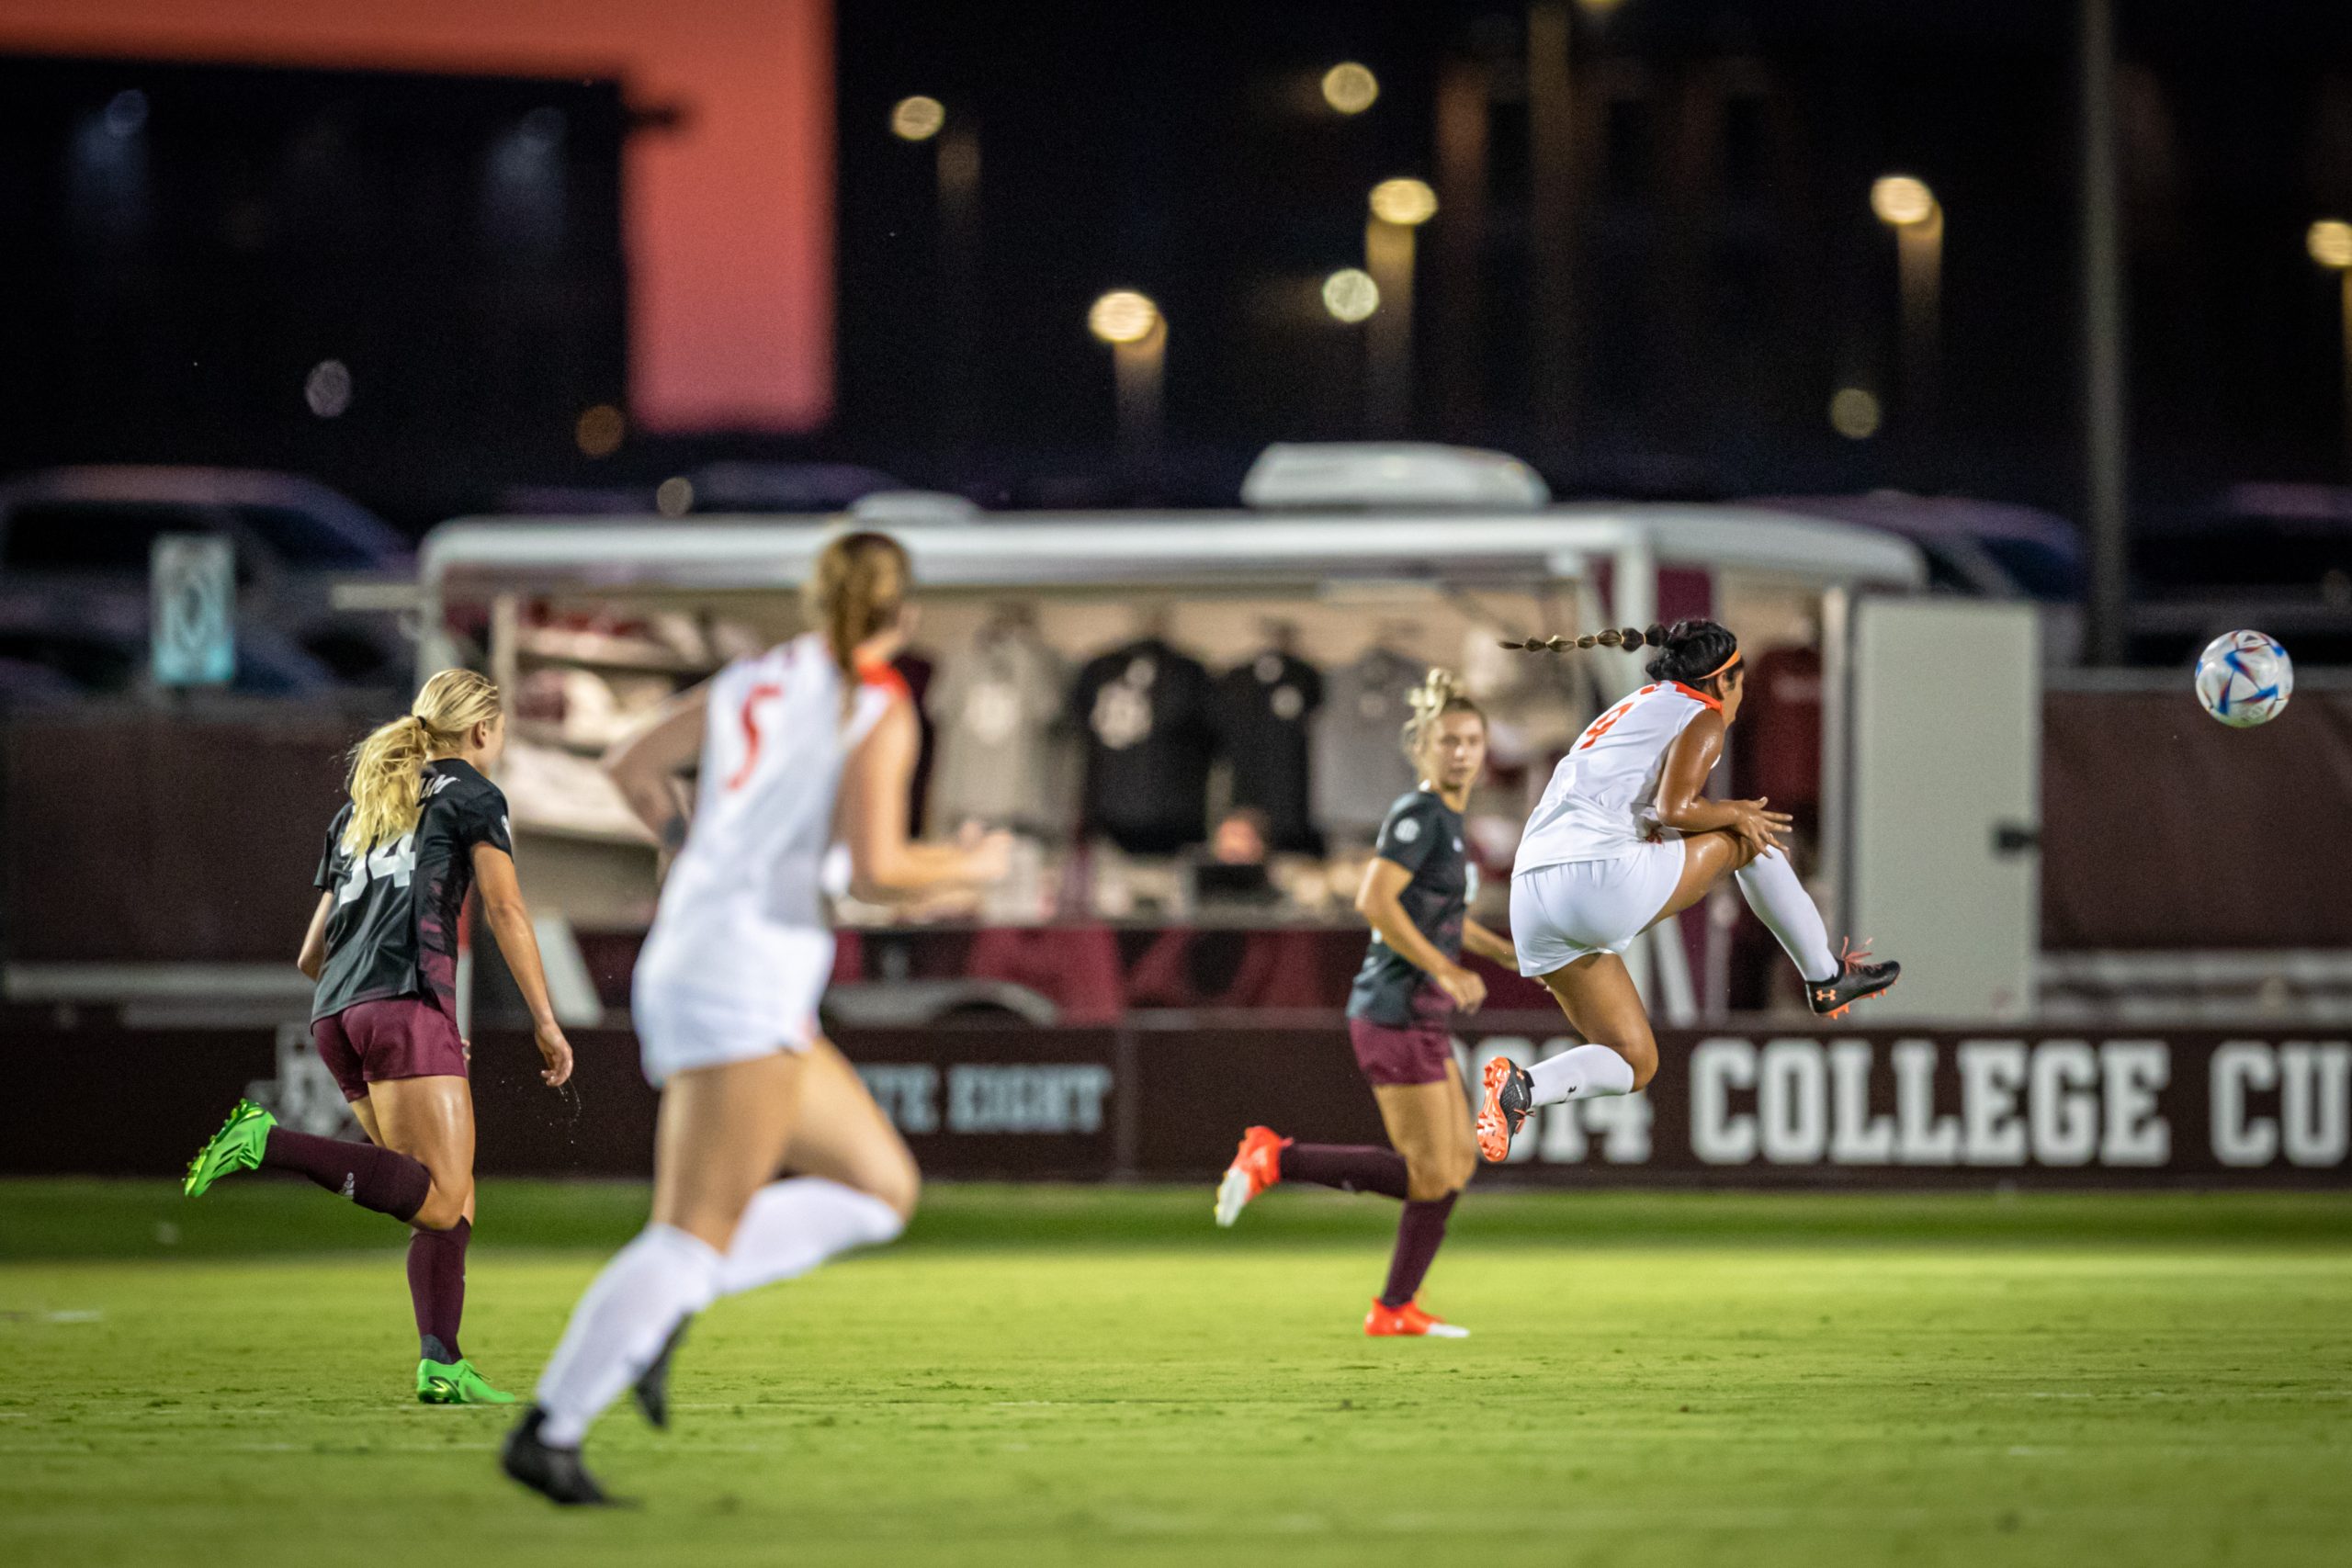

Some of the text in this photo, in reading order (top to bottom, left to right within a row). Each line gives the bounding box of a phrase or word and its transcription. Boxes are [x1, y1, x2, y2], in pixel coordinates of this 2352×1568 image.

[947, 1062, 1114, 1135] EIGHT
[1689, 1037, 2172, 1167] COLLEGE
[2209, 1038, 2352, 1168] CU
